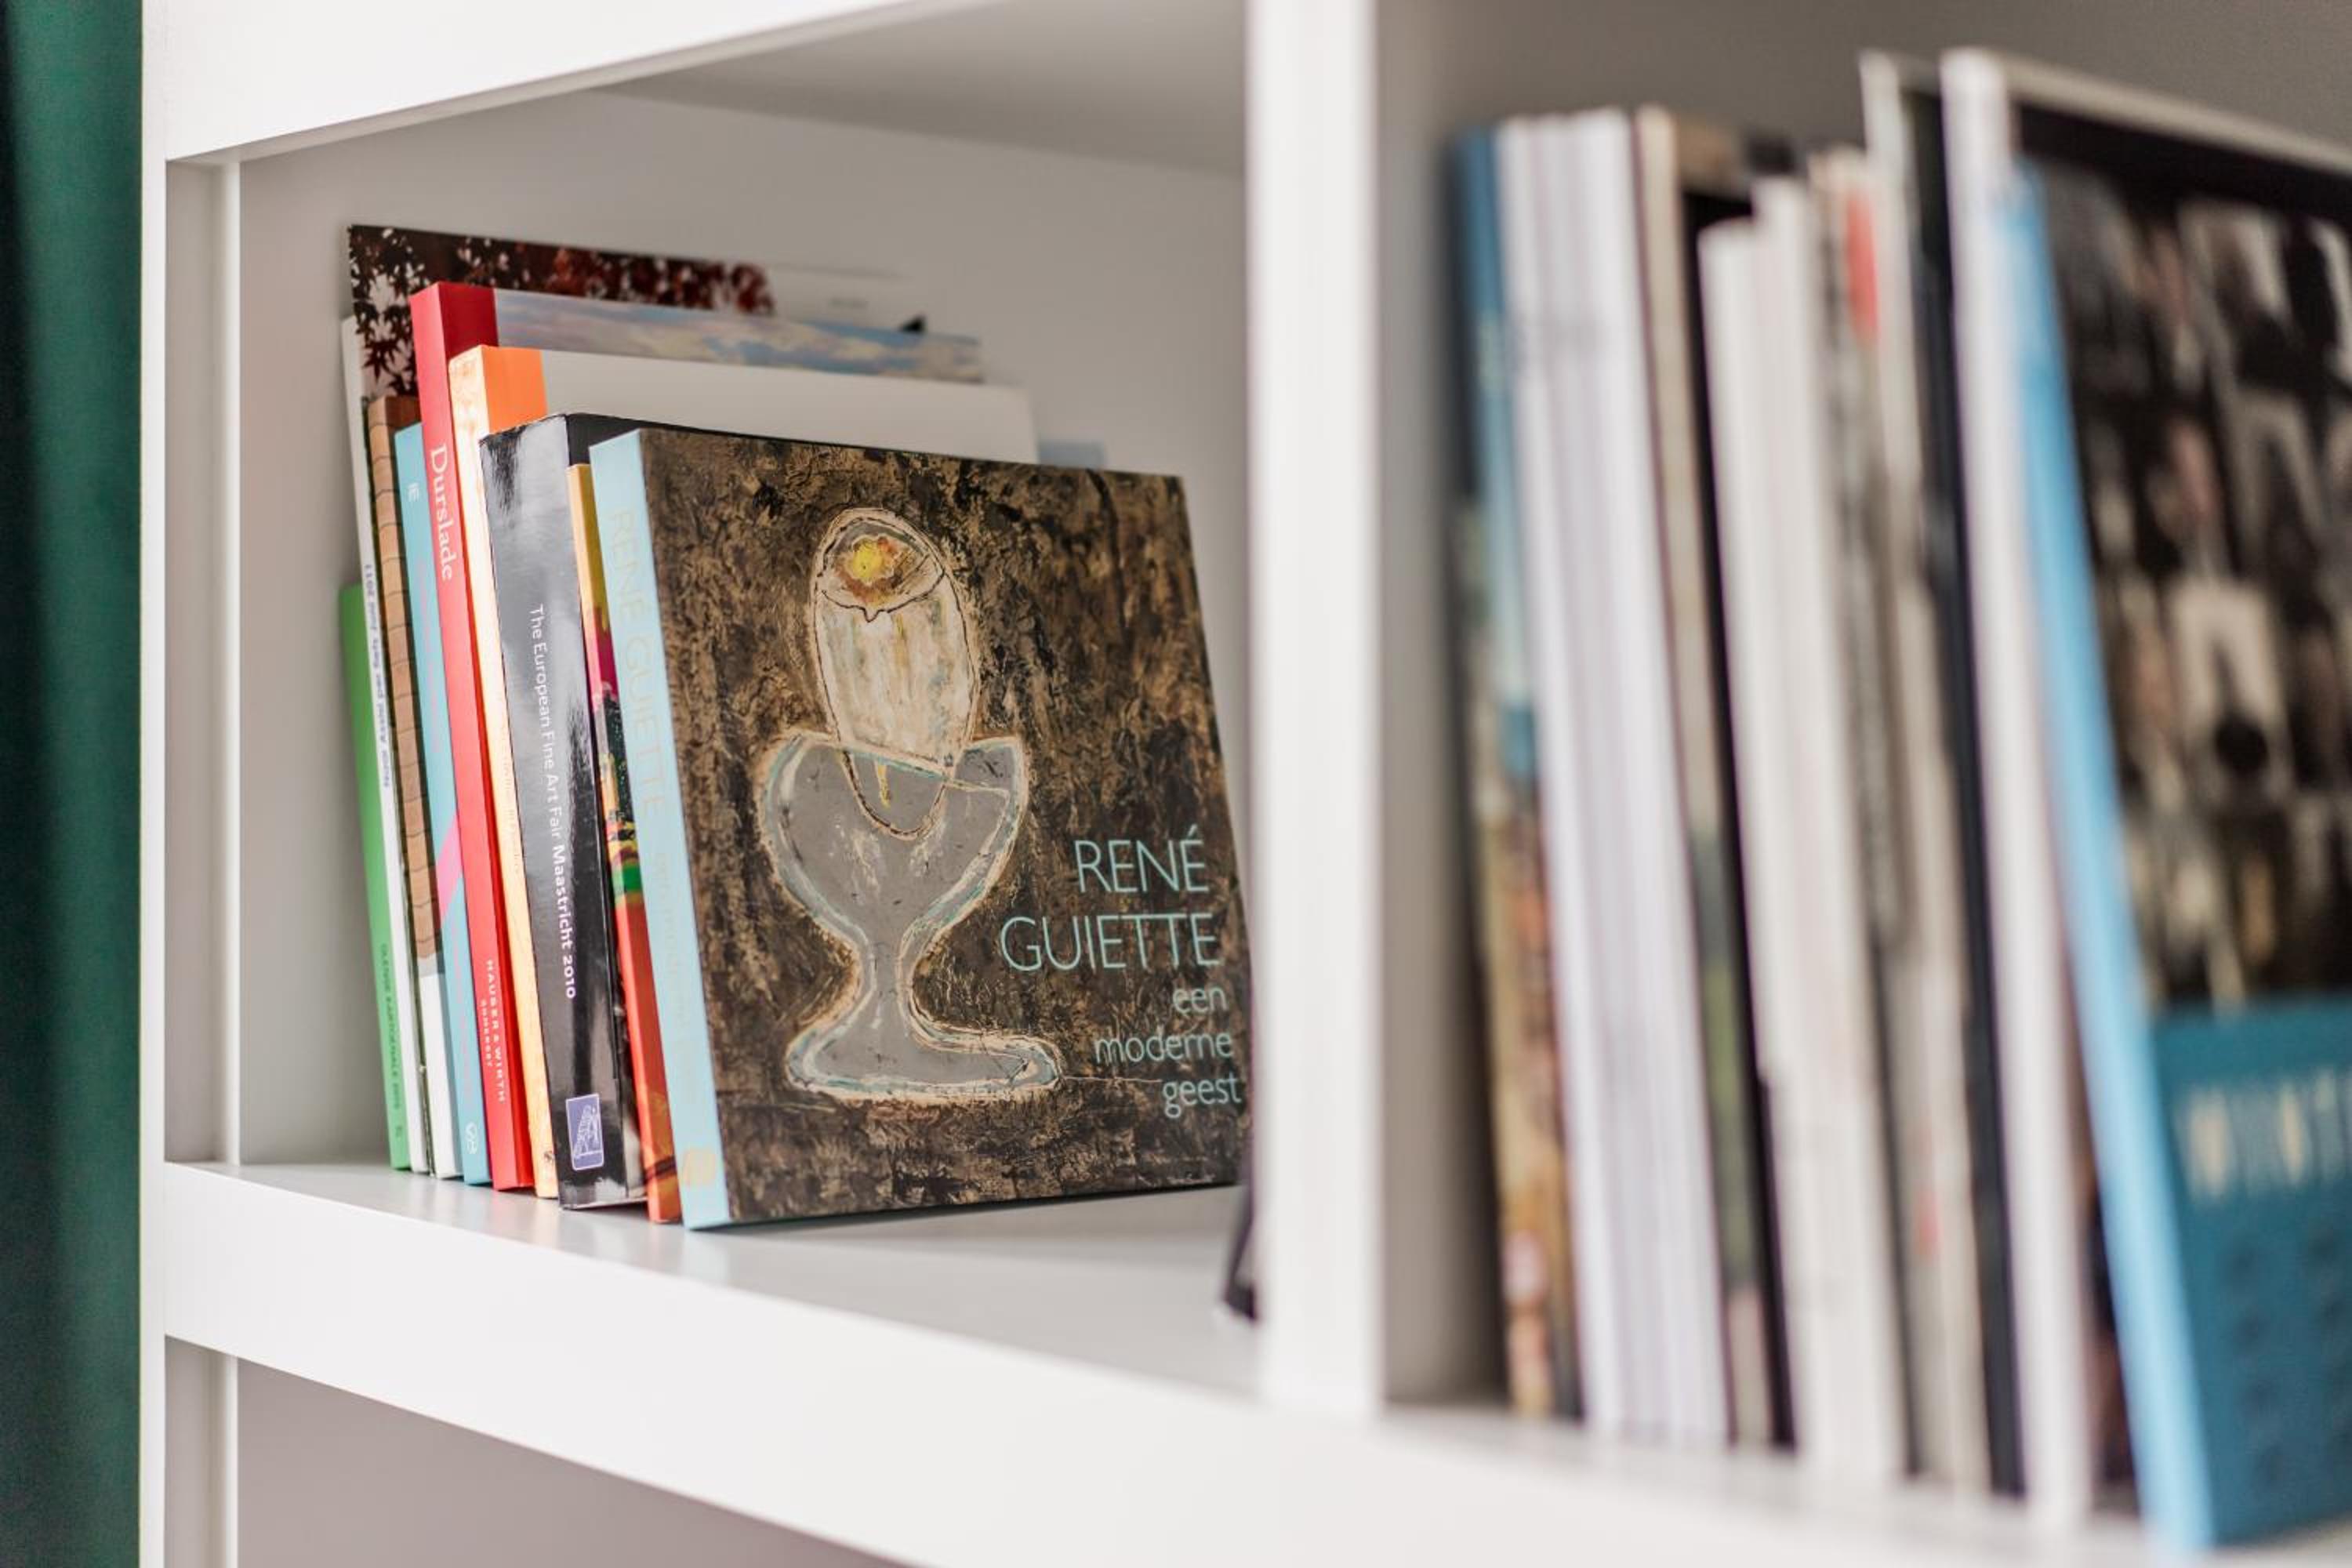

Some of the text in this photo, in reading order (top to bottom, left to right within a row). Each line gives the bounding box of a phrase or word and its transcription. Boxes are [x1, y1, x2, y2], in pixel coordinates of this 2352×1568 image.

[430, 443, 456, 581] Durslade
[626, 632, 667, 817] GUIETTE
[529, 603, 577, 1000] The European Fine Art Fair Maastricht 2010
[1073, 823, 1211, 894] RENÉ
[999, 913, 1223, 972] GUIETTE
[485, 958, 499, 1029] HAUSER
[494, 1046, 506, 1105] WIRTH
[1172, 985, 1229, 1015] een
[1094, 1025, 1235, 1065] moderne
[1161, 1071, 1243, 1120] geest
